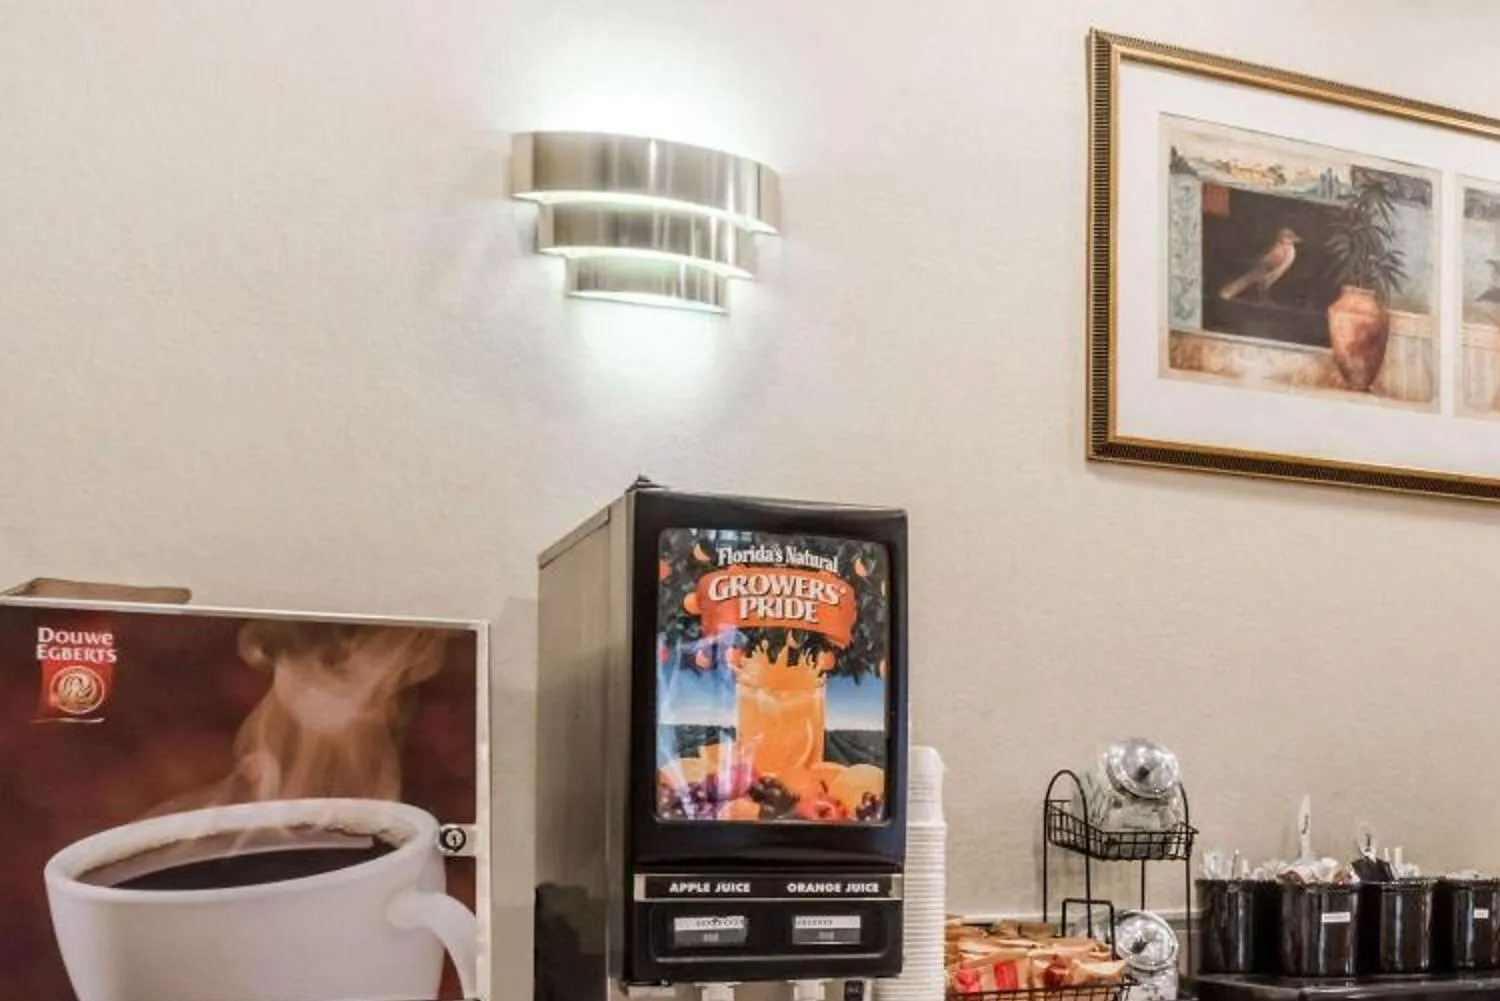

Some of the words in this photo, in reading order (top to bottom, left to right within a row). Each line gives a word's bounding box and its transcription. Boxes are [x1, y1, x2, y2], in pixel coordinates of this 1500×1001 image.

[716, 544, 784, 567] Florida's
[785, 546, 840, 573] Natural
[739, 596, 819, 624] PRIDE
[36, 643, 118, 664] EGBERTS
[669, 881, 711, 894] APPLE
[714, 881, 751, 894] JUICE
[787, 882, 842, 894] ORANGE
[845, 882, 880, 894] JUICE
